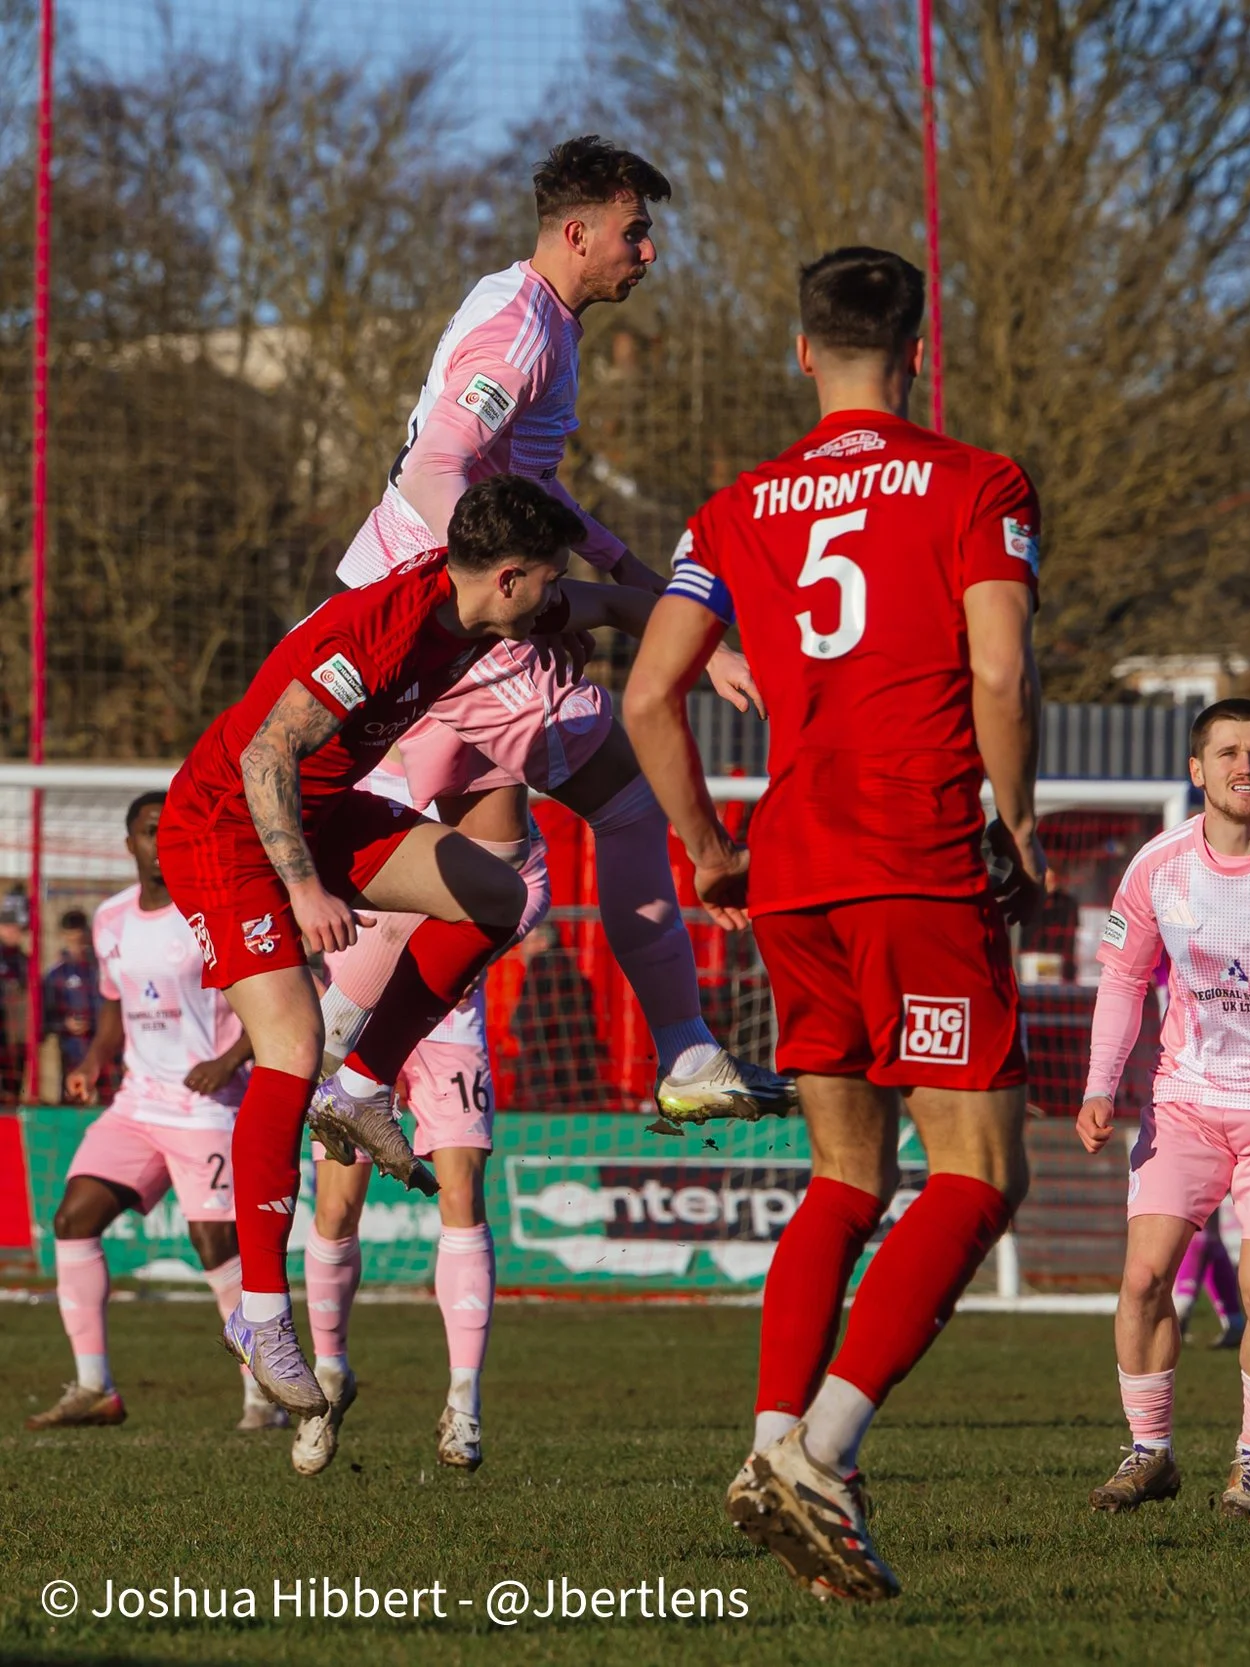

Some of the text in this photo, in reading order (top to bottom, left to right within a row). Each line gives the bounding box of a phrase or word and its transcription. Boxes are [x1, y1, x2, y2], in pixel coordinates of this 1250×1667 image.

[753, 460, 932, 519] THORNTON
[795, 508, 867, 659] 5
[1222, 1001, 1237, 1012] UK
[450, 1069, 490, 1113] 16
[207, 1153, 229, 1190] 2
